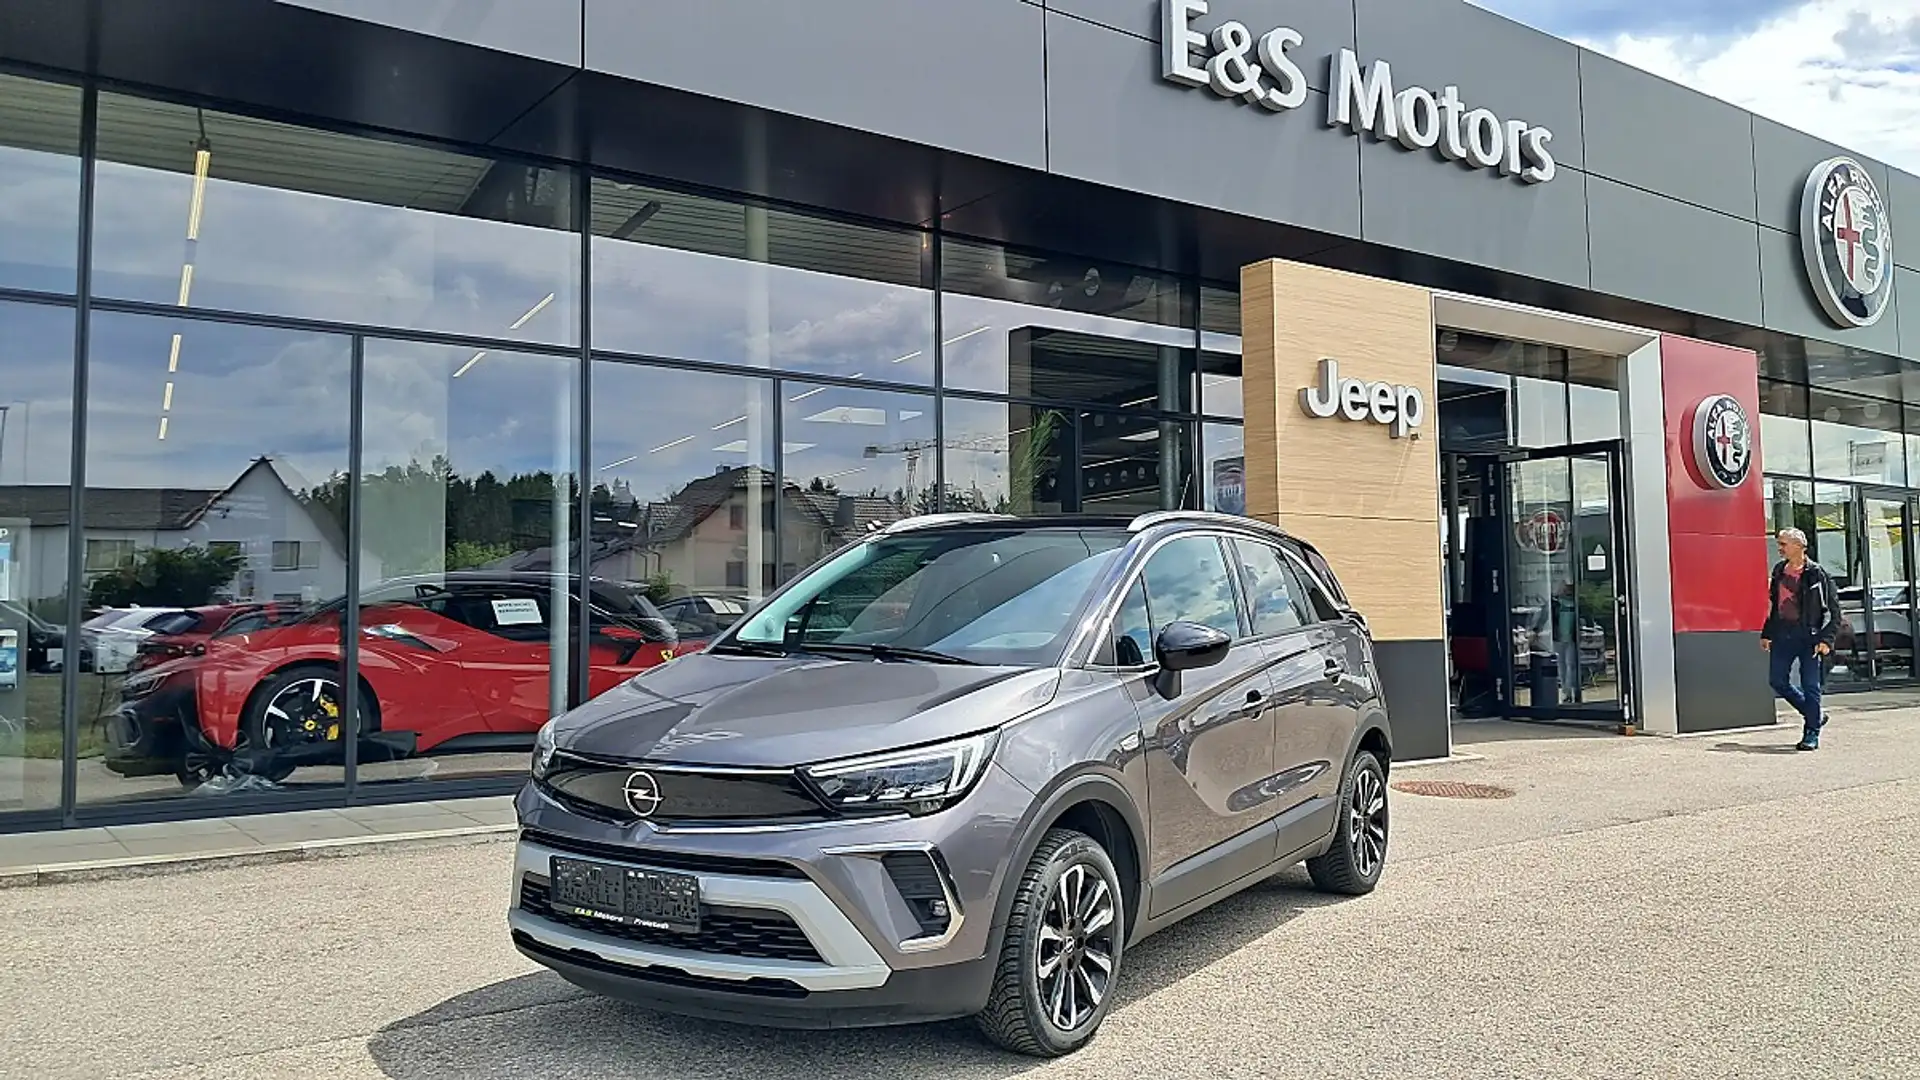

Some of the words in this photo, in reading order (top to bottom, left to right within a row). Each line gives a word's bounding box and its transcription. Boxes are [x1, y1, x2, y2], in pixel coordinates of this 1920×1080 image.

[1162, 0, 1307, 112] E&S
[1327, 48, 1556, 184] Motors
[1821, 172, 1846, 232] ALFA
[1298, 358, 1424, 439] Jeep
[1707, 405, 1724, 440] ALFA
[594, 910, 624, 923] Motors
